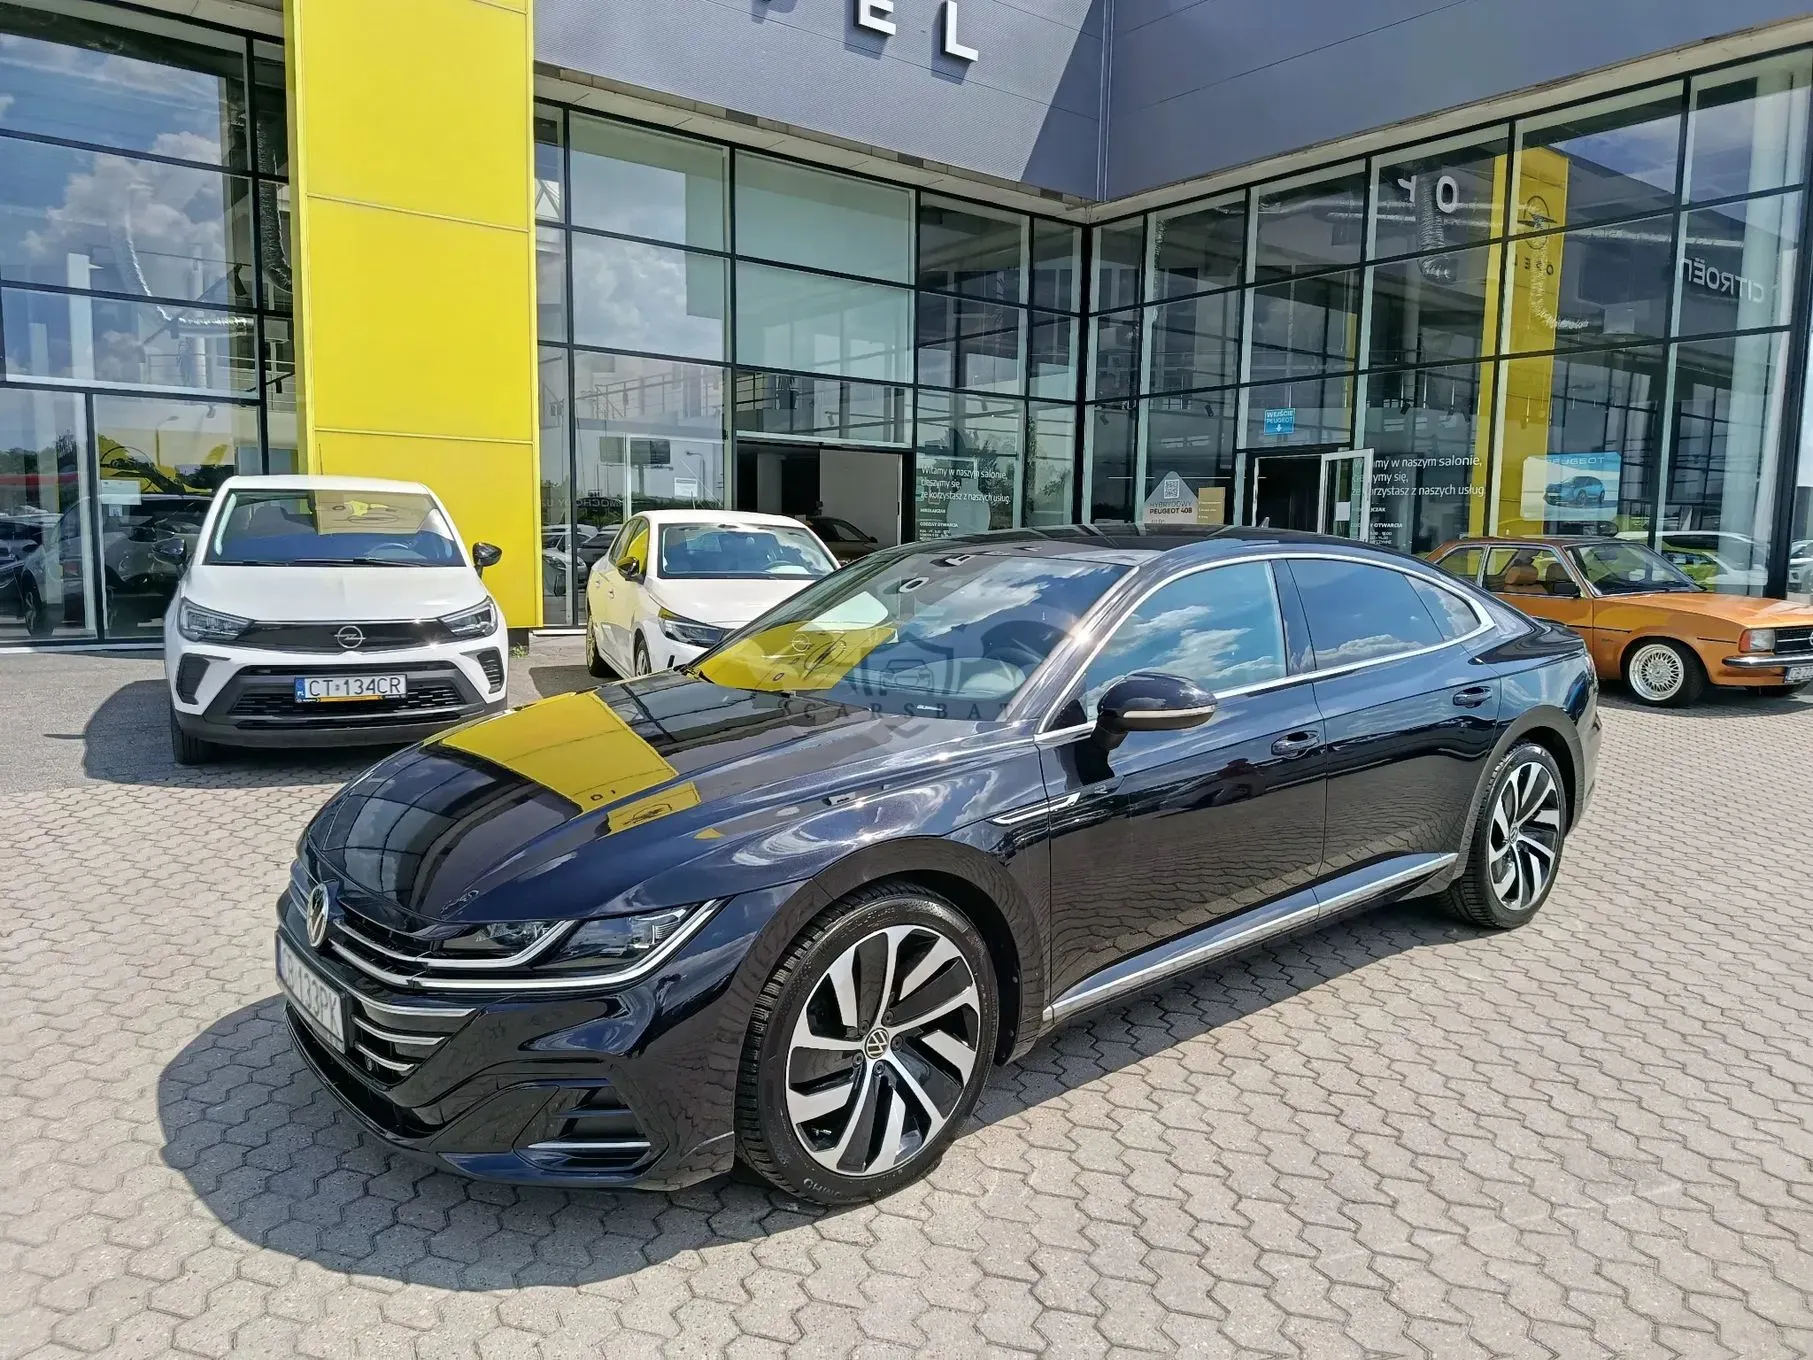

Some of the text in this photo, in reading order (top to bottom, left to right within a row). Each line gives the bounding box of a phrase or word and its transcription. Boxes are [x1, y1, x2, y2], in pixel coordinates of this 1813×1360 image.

[1266, 409, 1294, 417] WEJŚCIE
[1266, 416, 1293, 424] PEUGEOT
[1401, 459, 1437, 469] naszym
[1438, 455, 1482, 467] salonie,
[1410, 487, 1417, 495] z
[1418, 484, 1456, 497] naszych
